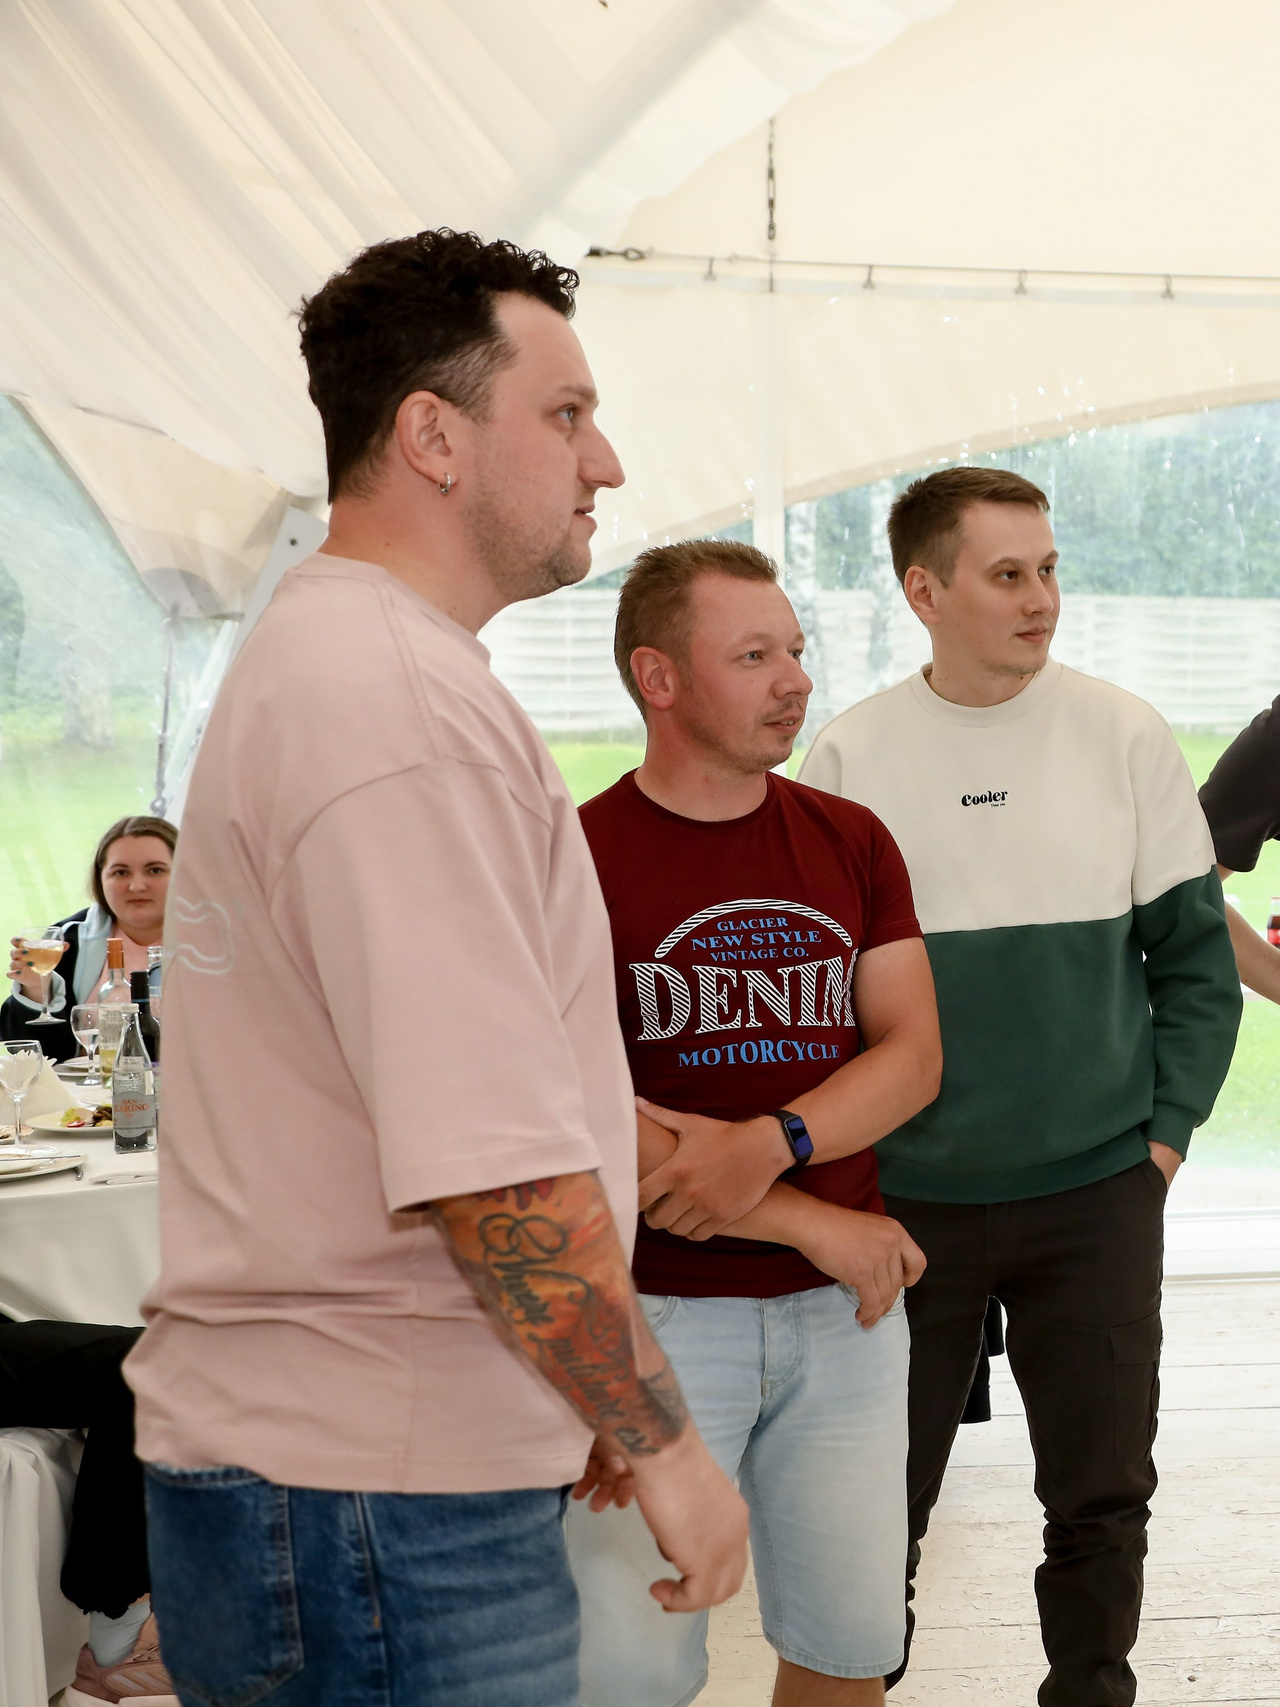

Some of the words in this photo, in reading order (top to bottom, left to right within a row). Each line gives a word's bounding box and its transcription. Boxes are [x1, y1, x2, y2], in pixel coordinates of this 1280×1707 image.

[961, 790, 1008, 807] Cooler
[716, 917, 789, 932] GLACIER
[690, 937, 744, 951] NEW
[751, 930, 822, 947] STYLE
[709, 948, 779, 962] VINTAGE
[783, 947, 809, 958] CO.
[628, 948, 859, 1041] DENIM
[678, 1039, 841, 1067] MOTORCYCLE
